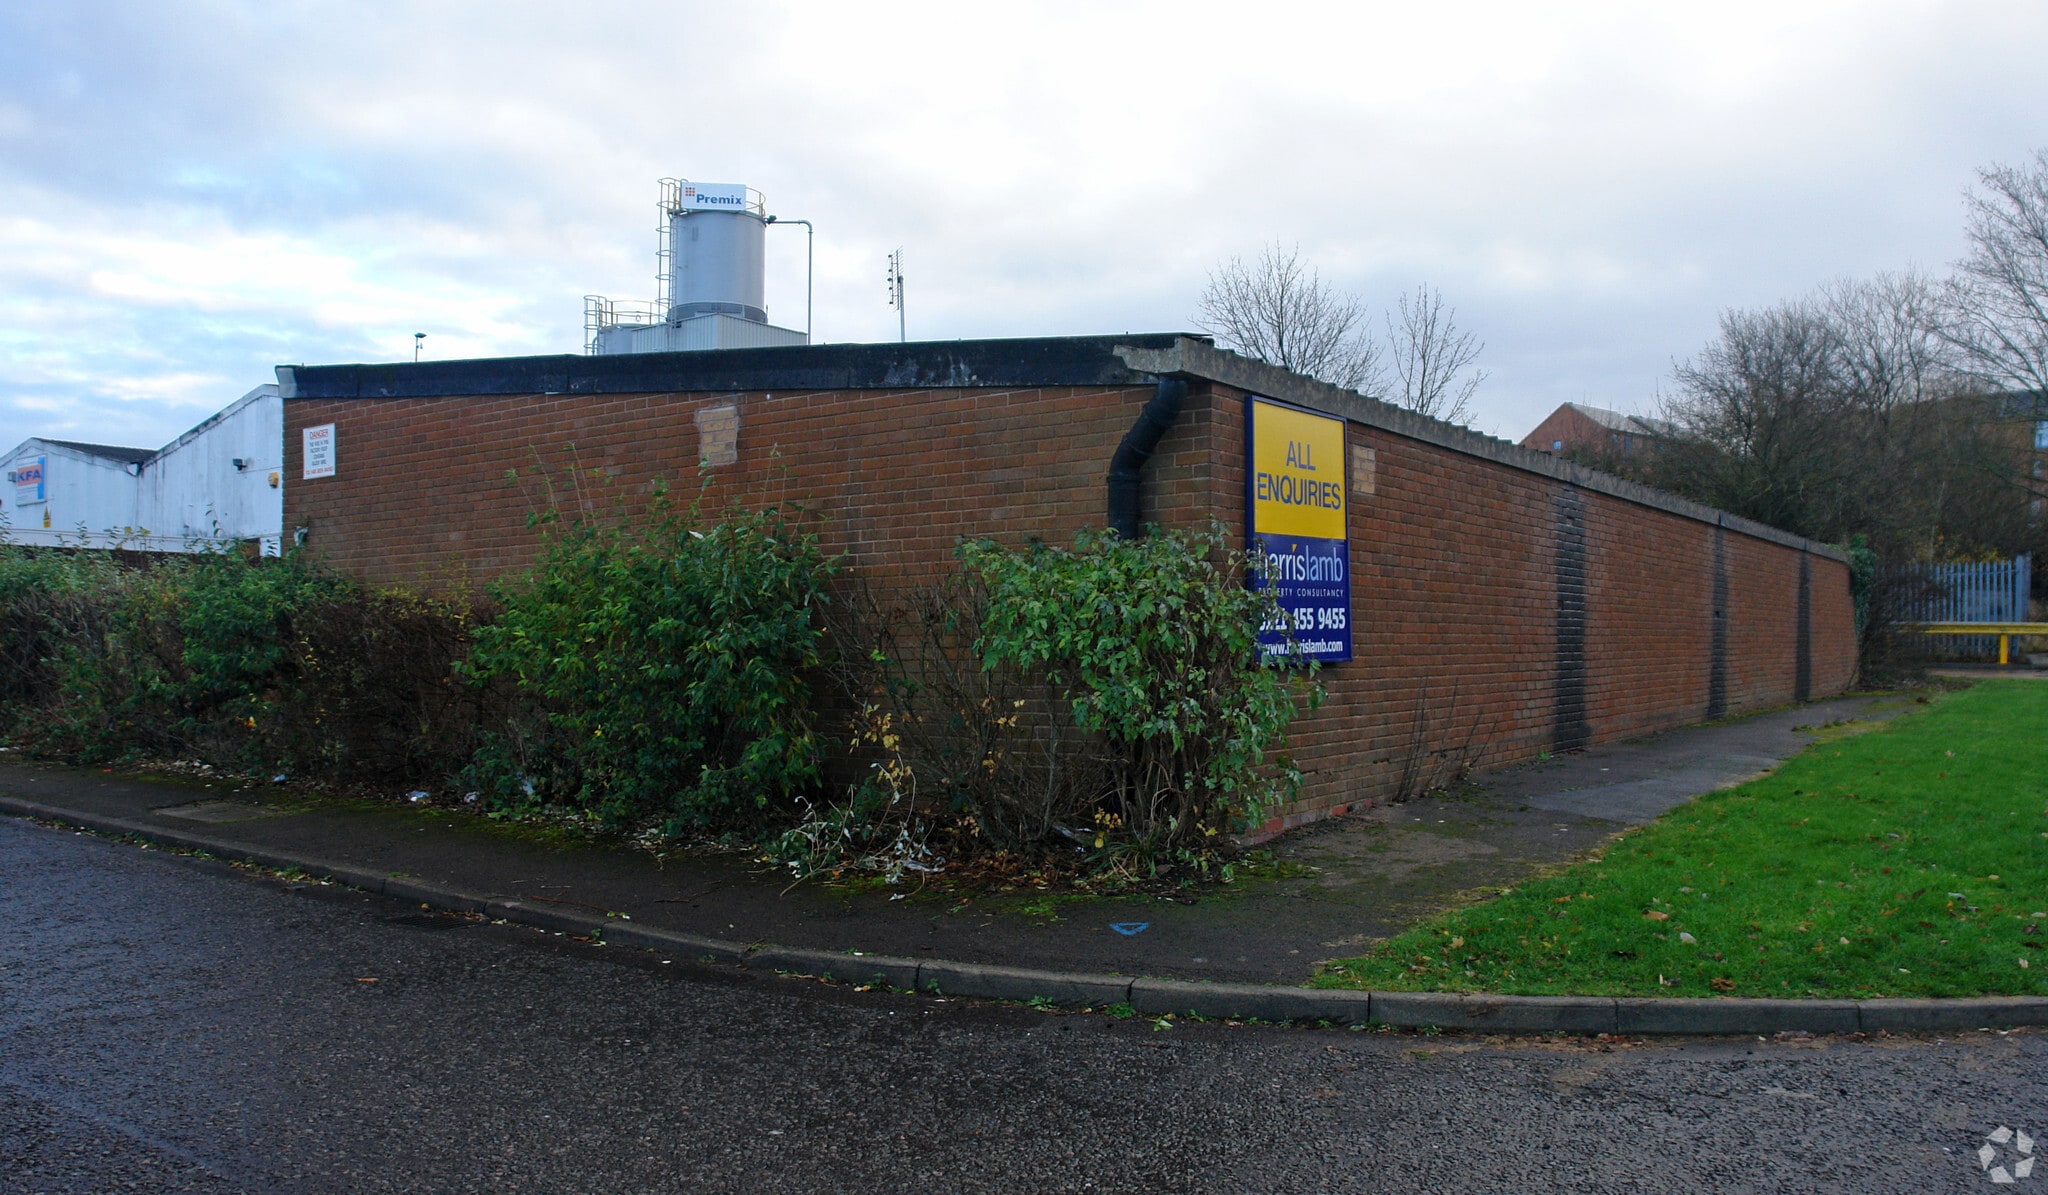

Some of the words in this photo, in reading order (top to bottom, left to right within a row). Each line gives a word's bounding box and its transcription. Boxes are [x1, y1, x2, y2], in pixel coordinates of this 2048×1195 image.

[696, 194, 742, 205] Premix
[1286, 440, 1316, 471] ALL
[17, 469, 42, 482] KFA
[1257, 472, 1341, 510] ENQUIRIES
[1296, 588, 1344, 598] CONSULTANCY
[1293, 607, 1314, 630] 455
[1318, 607, 1346, 630] 9455
